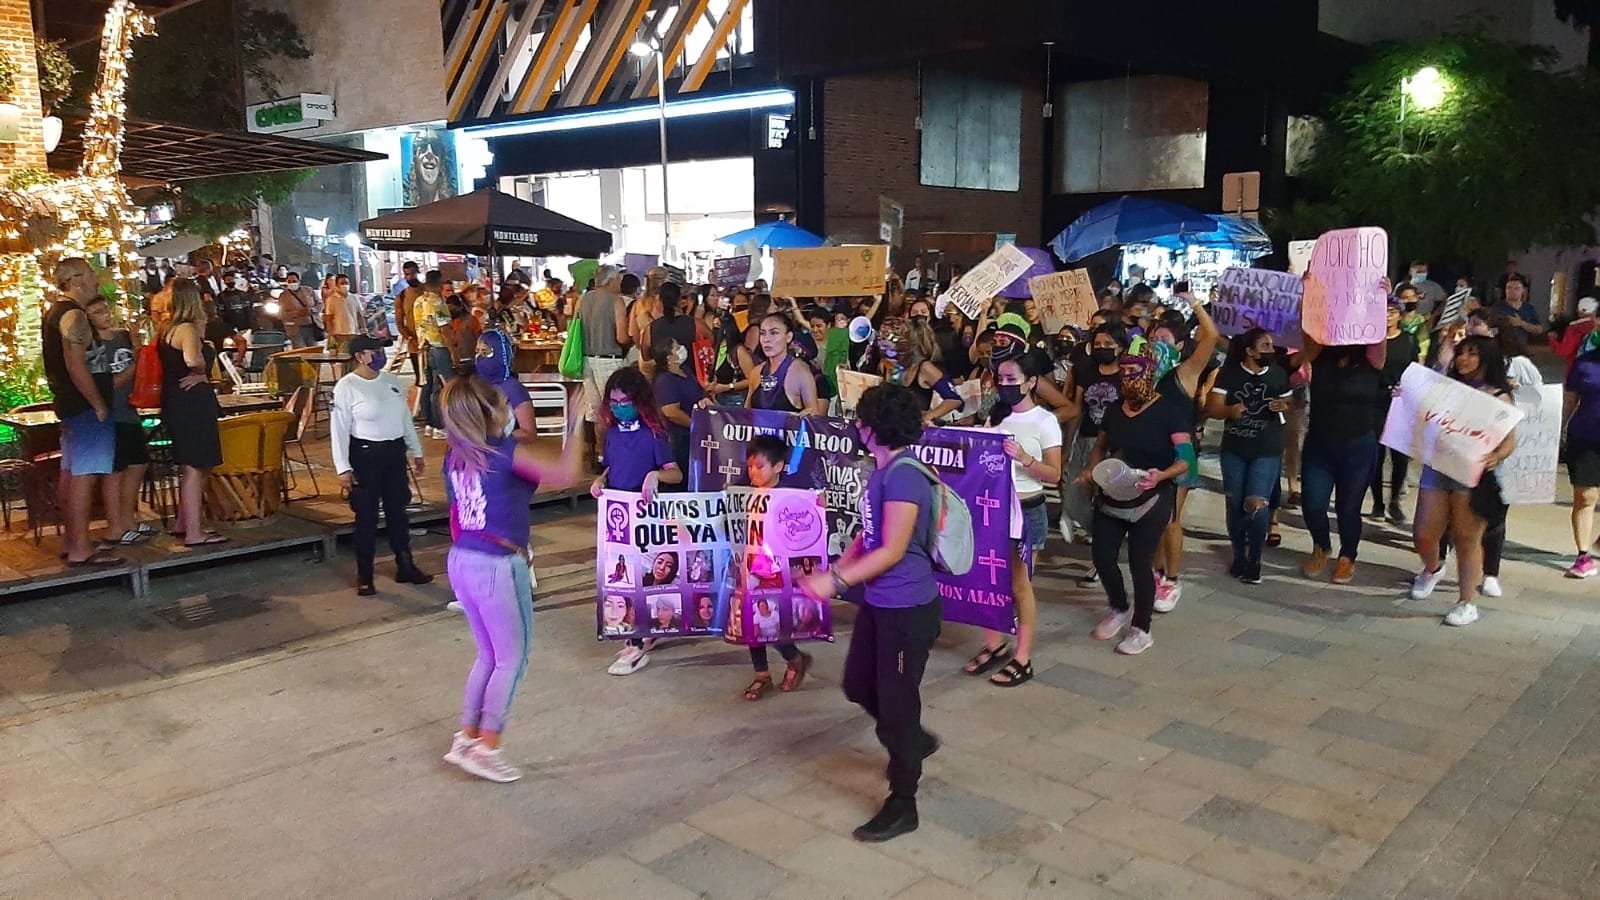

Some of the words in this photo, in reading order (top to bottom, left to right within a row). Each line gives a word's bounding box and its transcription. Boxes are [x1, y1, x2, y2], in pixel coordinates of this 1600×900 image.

[366, 228, 411, 238] MONTELOBOS
[493, 231, 538, 242] MONTELOBOS
[814, 432, 852, 454] ROO
[636, 499, 699, 520] SOMOS
[705, 496, 727, 517] LA
[733, 493, 745, 513] DE
[746, 494, 771, 514] LAS
[634, 523, 679, 553] QUE
[687, 524, 717, 543] YA
